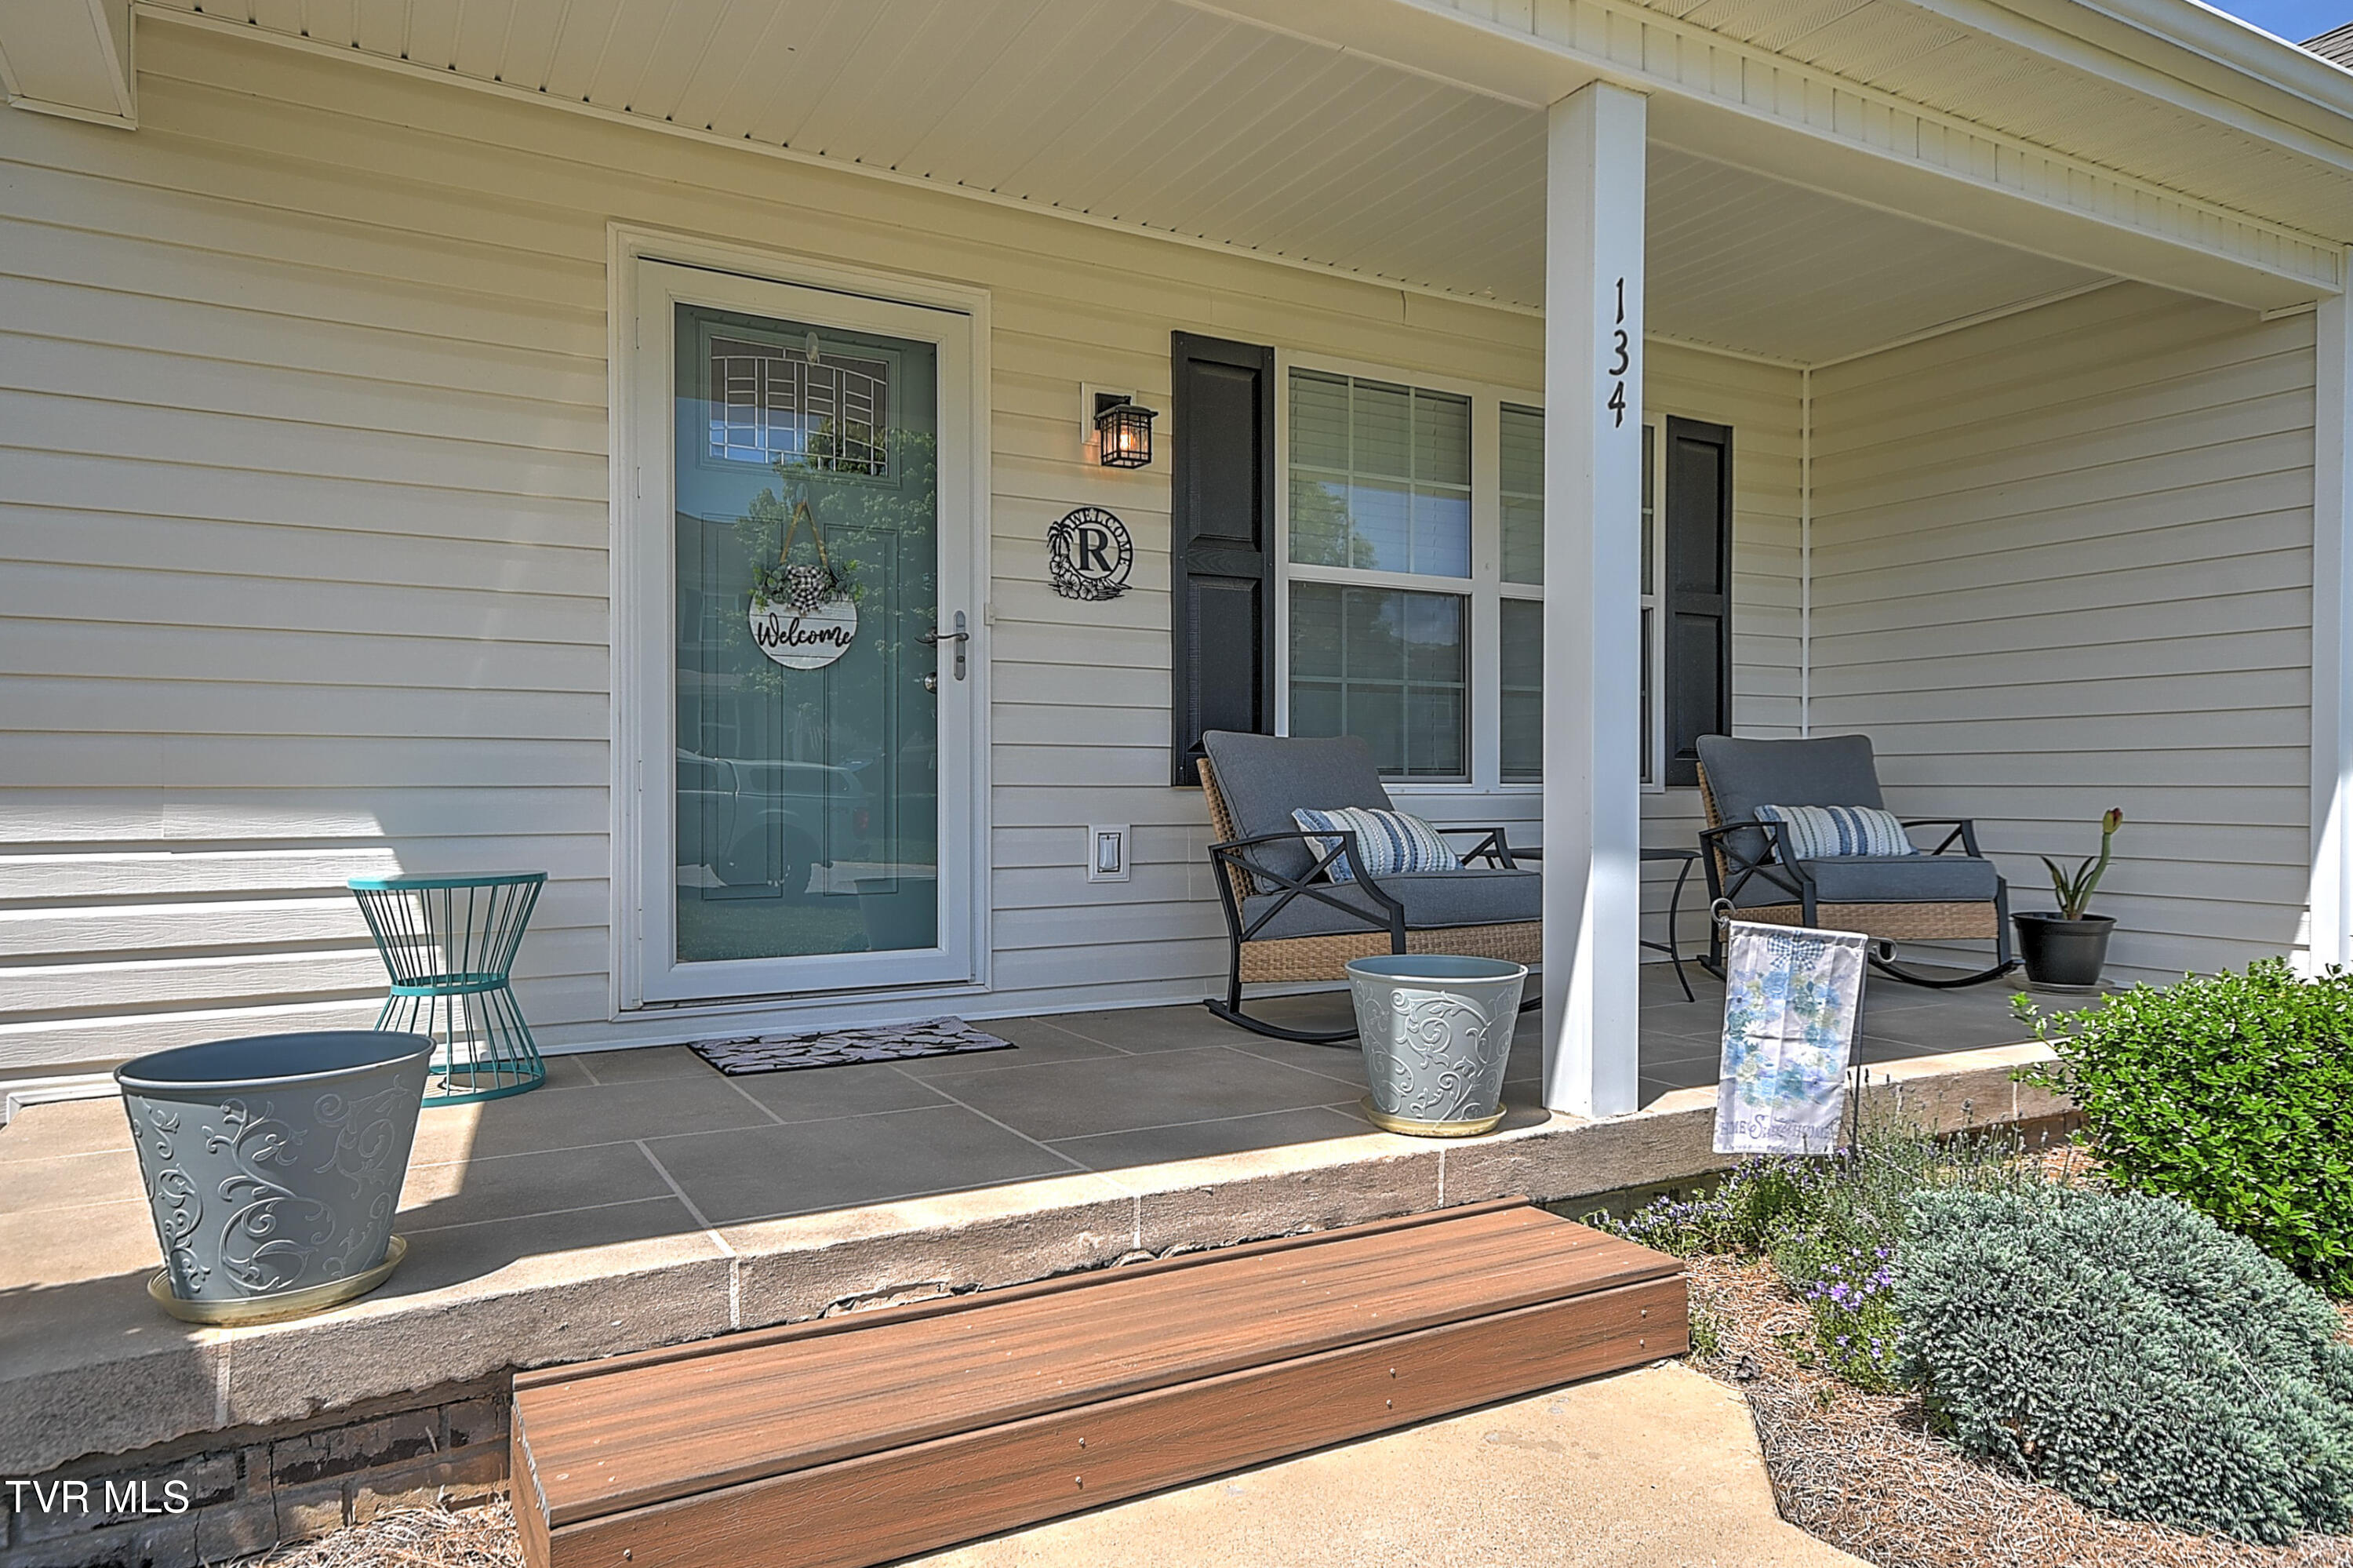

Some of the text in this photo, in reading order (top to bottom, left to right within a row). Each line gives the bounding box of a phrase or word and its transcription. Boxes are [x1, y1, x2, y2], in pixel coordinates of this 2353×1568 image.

[1608, 277, 1629, 428] 134
[1067, 508, 1130, 566] WELCOME
[1077, 528, 1112, 571] R
[758, 613, 853, 647] Welcome
